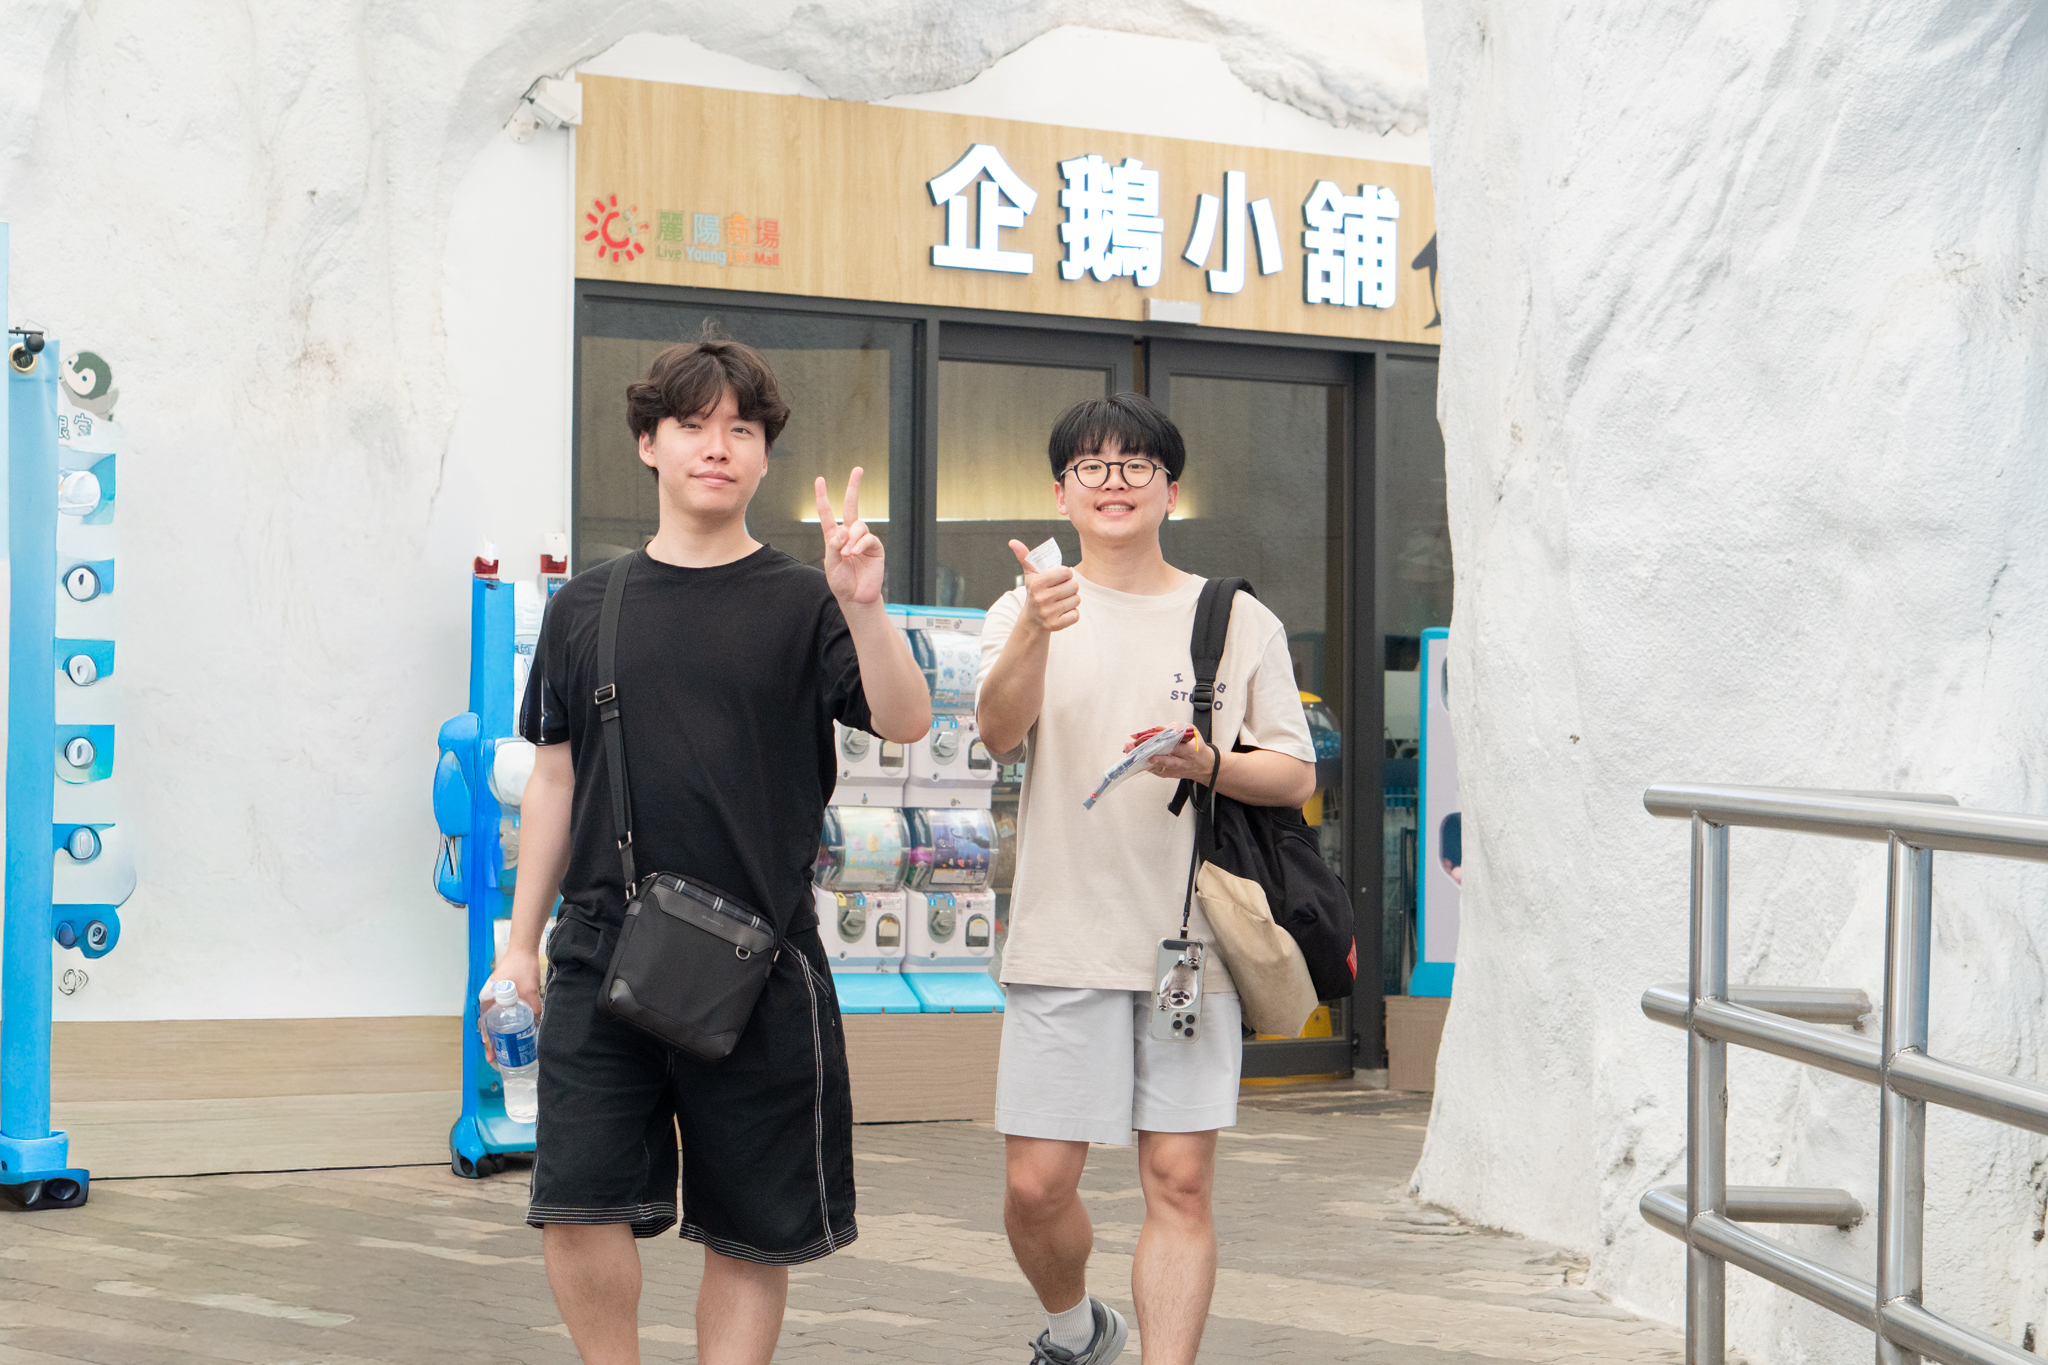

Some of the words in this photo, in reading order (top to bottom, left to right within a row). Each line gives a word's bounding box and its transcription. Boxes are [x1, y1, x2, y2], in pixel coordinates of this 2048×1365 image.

[658, 211, 780, 249] 麗陽商場
[657, 245, 682, 260] Live
[686, 246, 727, 266] Young
[728, 249, 751, 265] Life
[754, 252, 779, 266] Mall
[1170, 690, 1223, 711] STO
